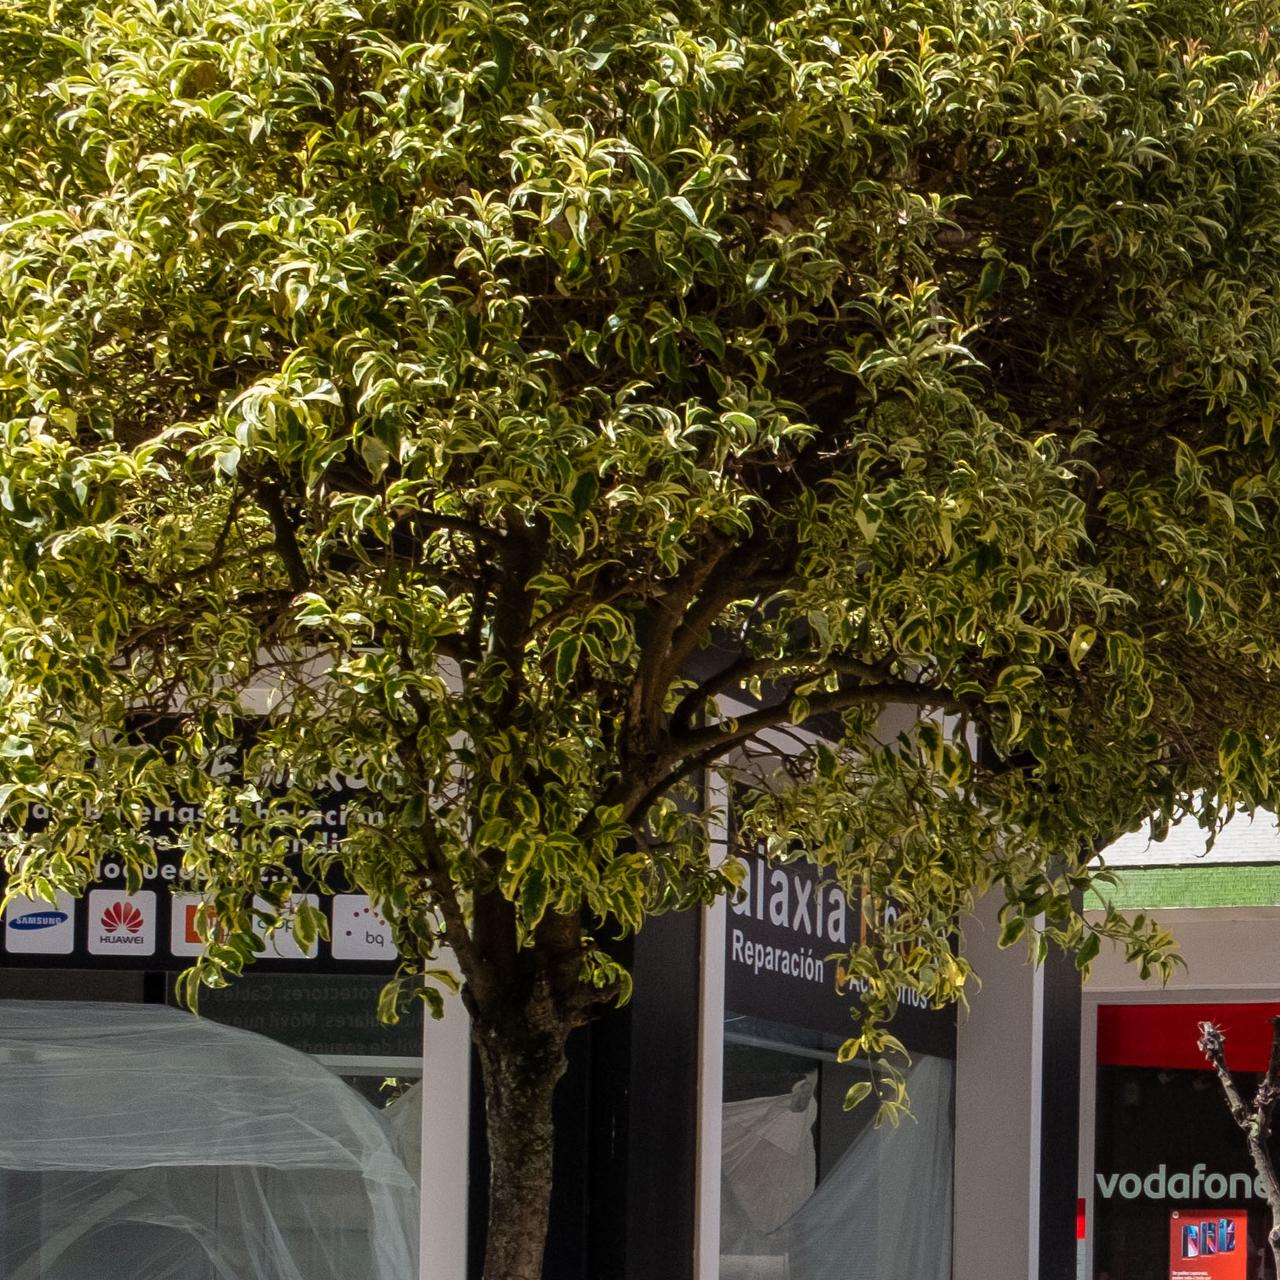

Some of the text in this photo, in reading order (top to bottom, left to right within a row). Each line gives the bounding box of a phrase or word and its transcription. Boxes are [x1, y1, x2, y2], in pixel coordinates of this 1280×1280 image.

[16, 916, 62, 925] SAMSUNG
[100, 935, 145, 946] HUAWEI
[366, 931, 385, 947] bq
[732, 929, 825, 983] Reparación
